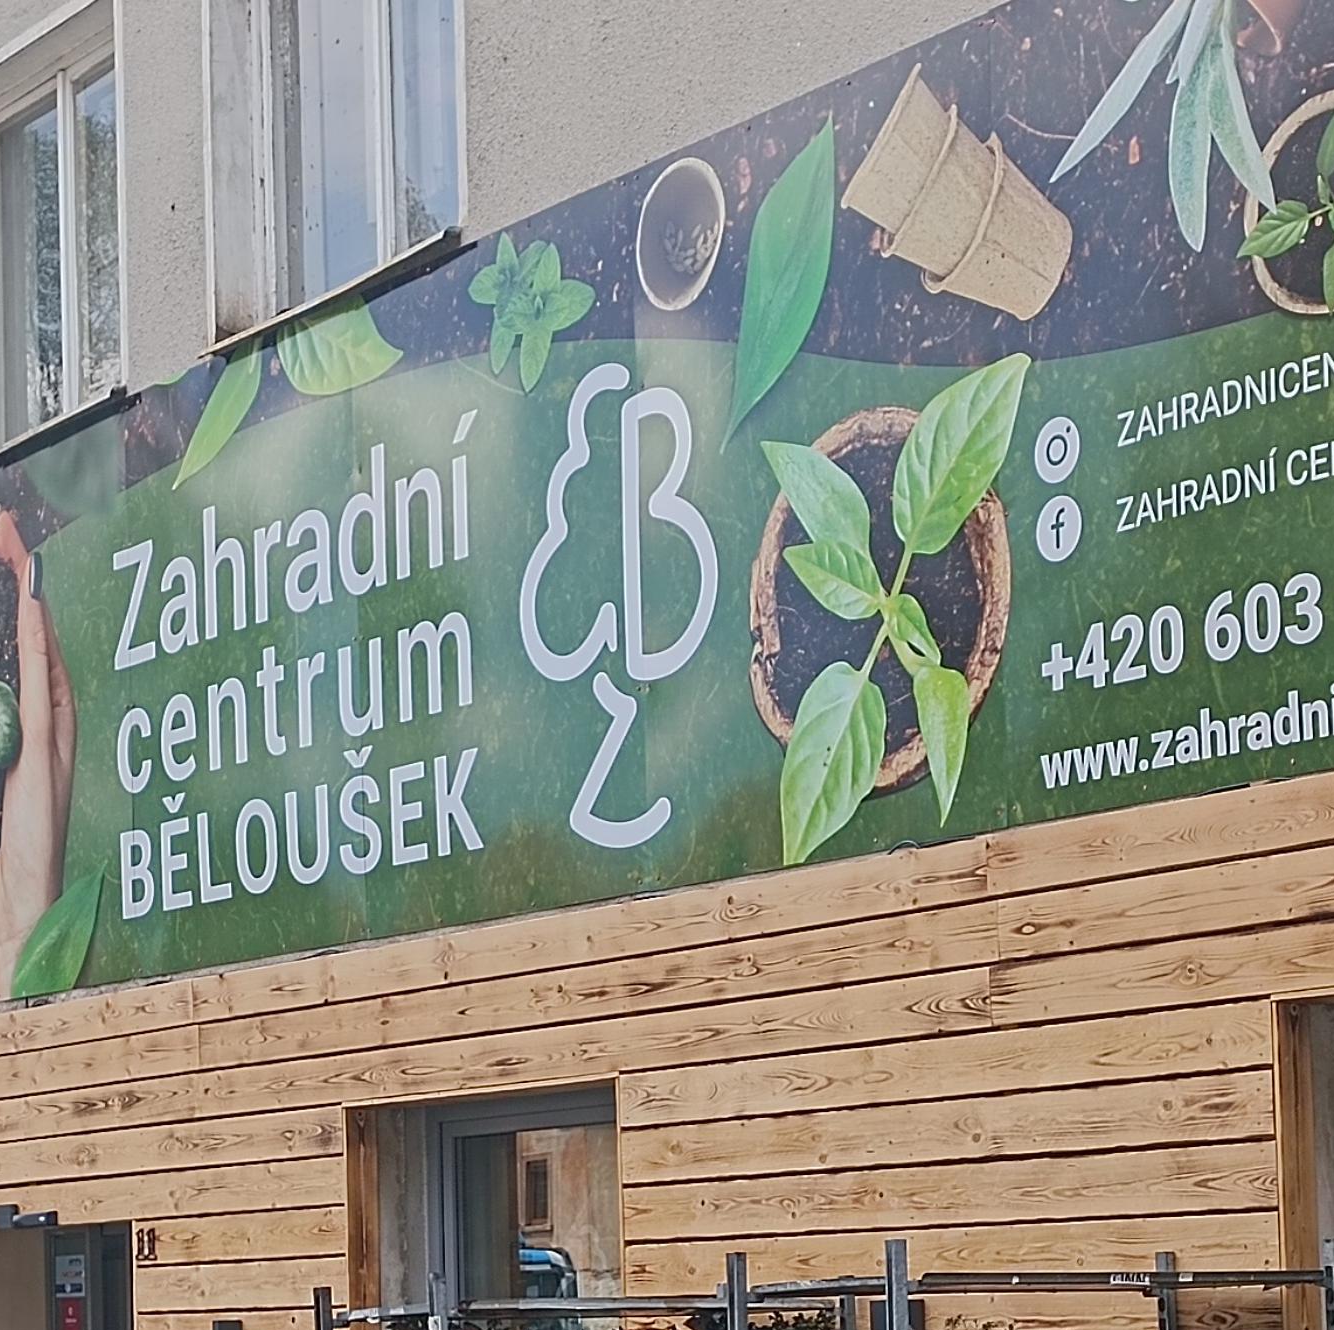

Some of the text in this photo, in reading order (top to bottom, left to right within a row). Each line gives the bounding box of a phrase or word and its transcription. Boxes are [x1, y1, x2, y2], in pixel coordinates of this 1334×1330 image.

[112, 409, 478, 671] Zahradní
[1116, 446, 1279, 533] ZAHRADNÍ
[116, 611, 474, 794] centrum
[1041, 604, 1185, 693] +420
[1204, 571, 1323, 662] 603
[119, 745, 485, 920] BĚLOUŠEK
